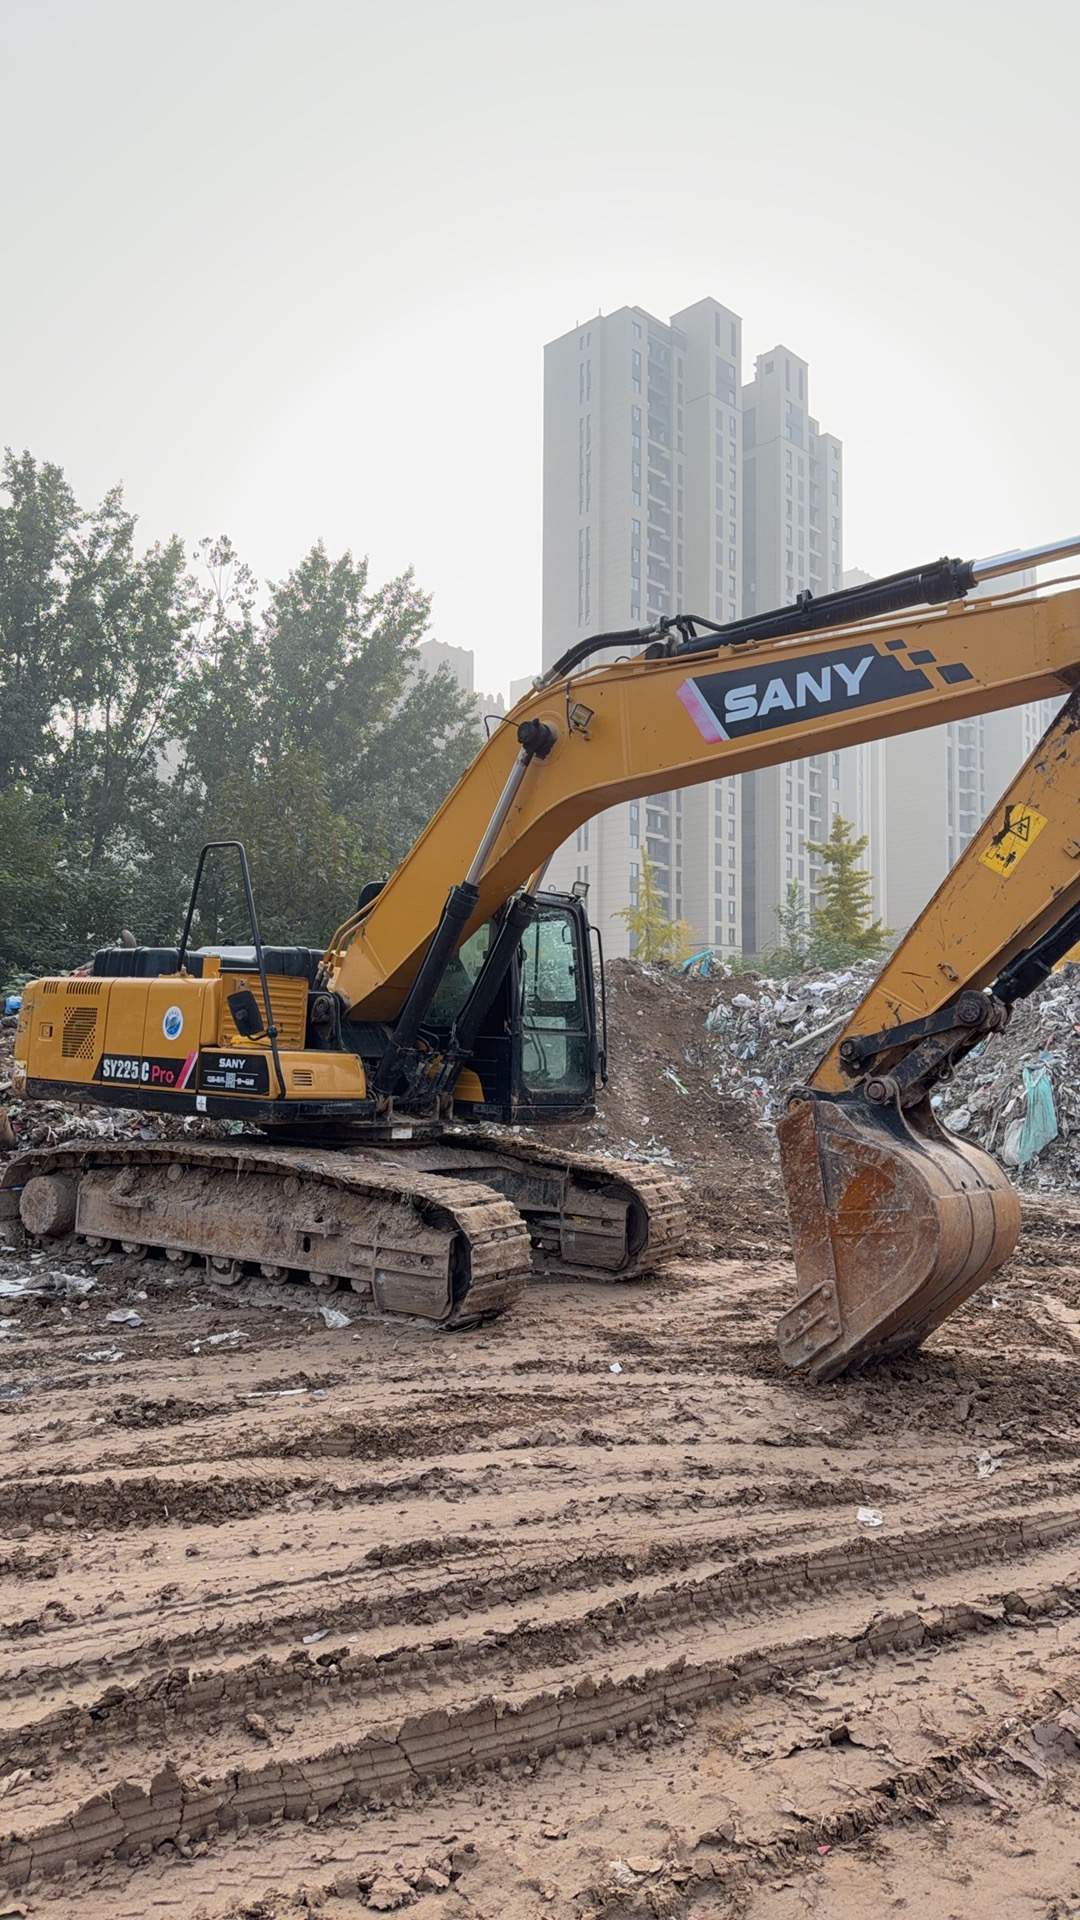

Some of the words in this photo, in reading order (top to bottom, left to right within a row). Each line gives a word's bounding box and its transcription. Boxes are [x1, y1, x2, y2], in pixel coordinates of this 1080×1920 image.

[724, 655, 875, 723] SANY
[218, 1058, 246, 1069] SANY
[151, 1065, 174, 1084] Pro
